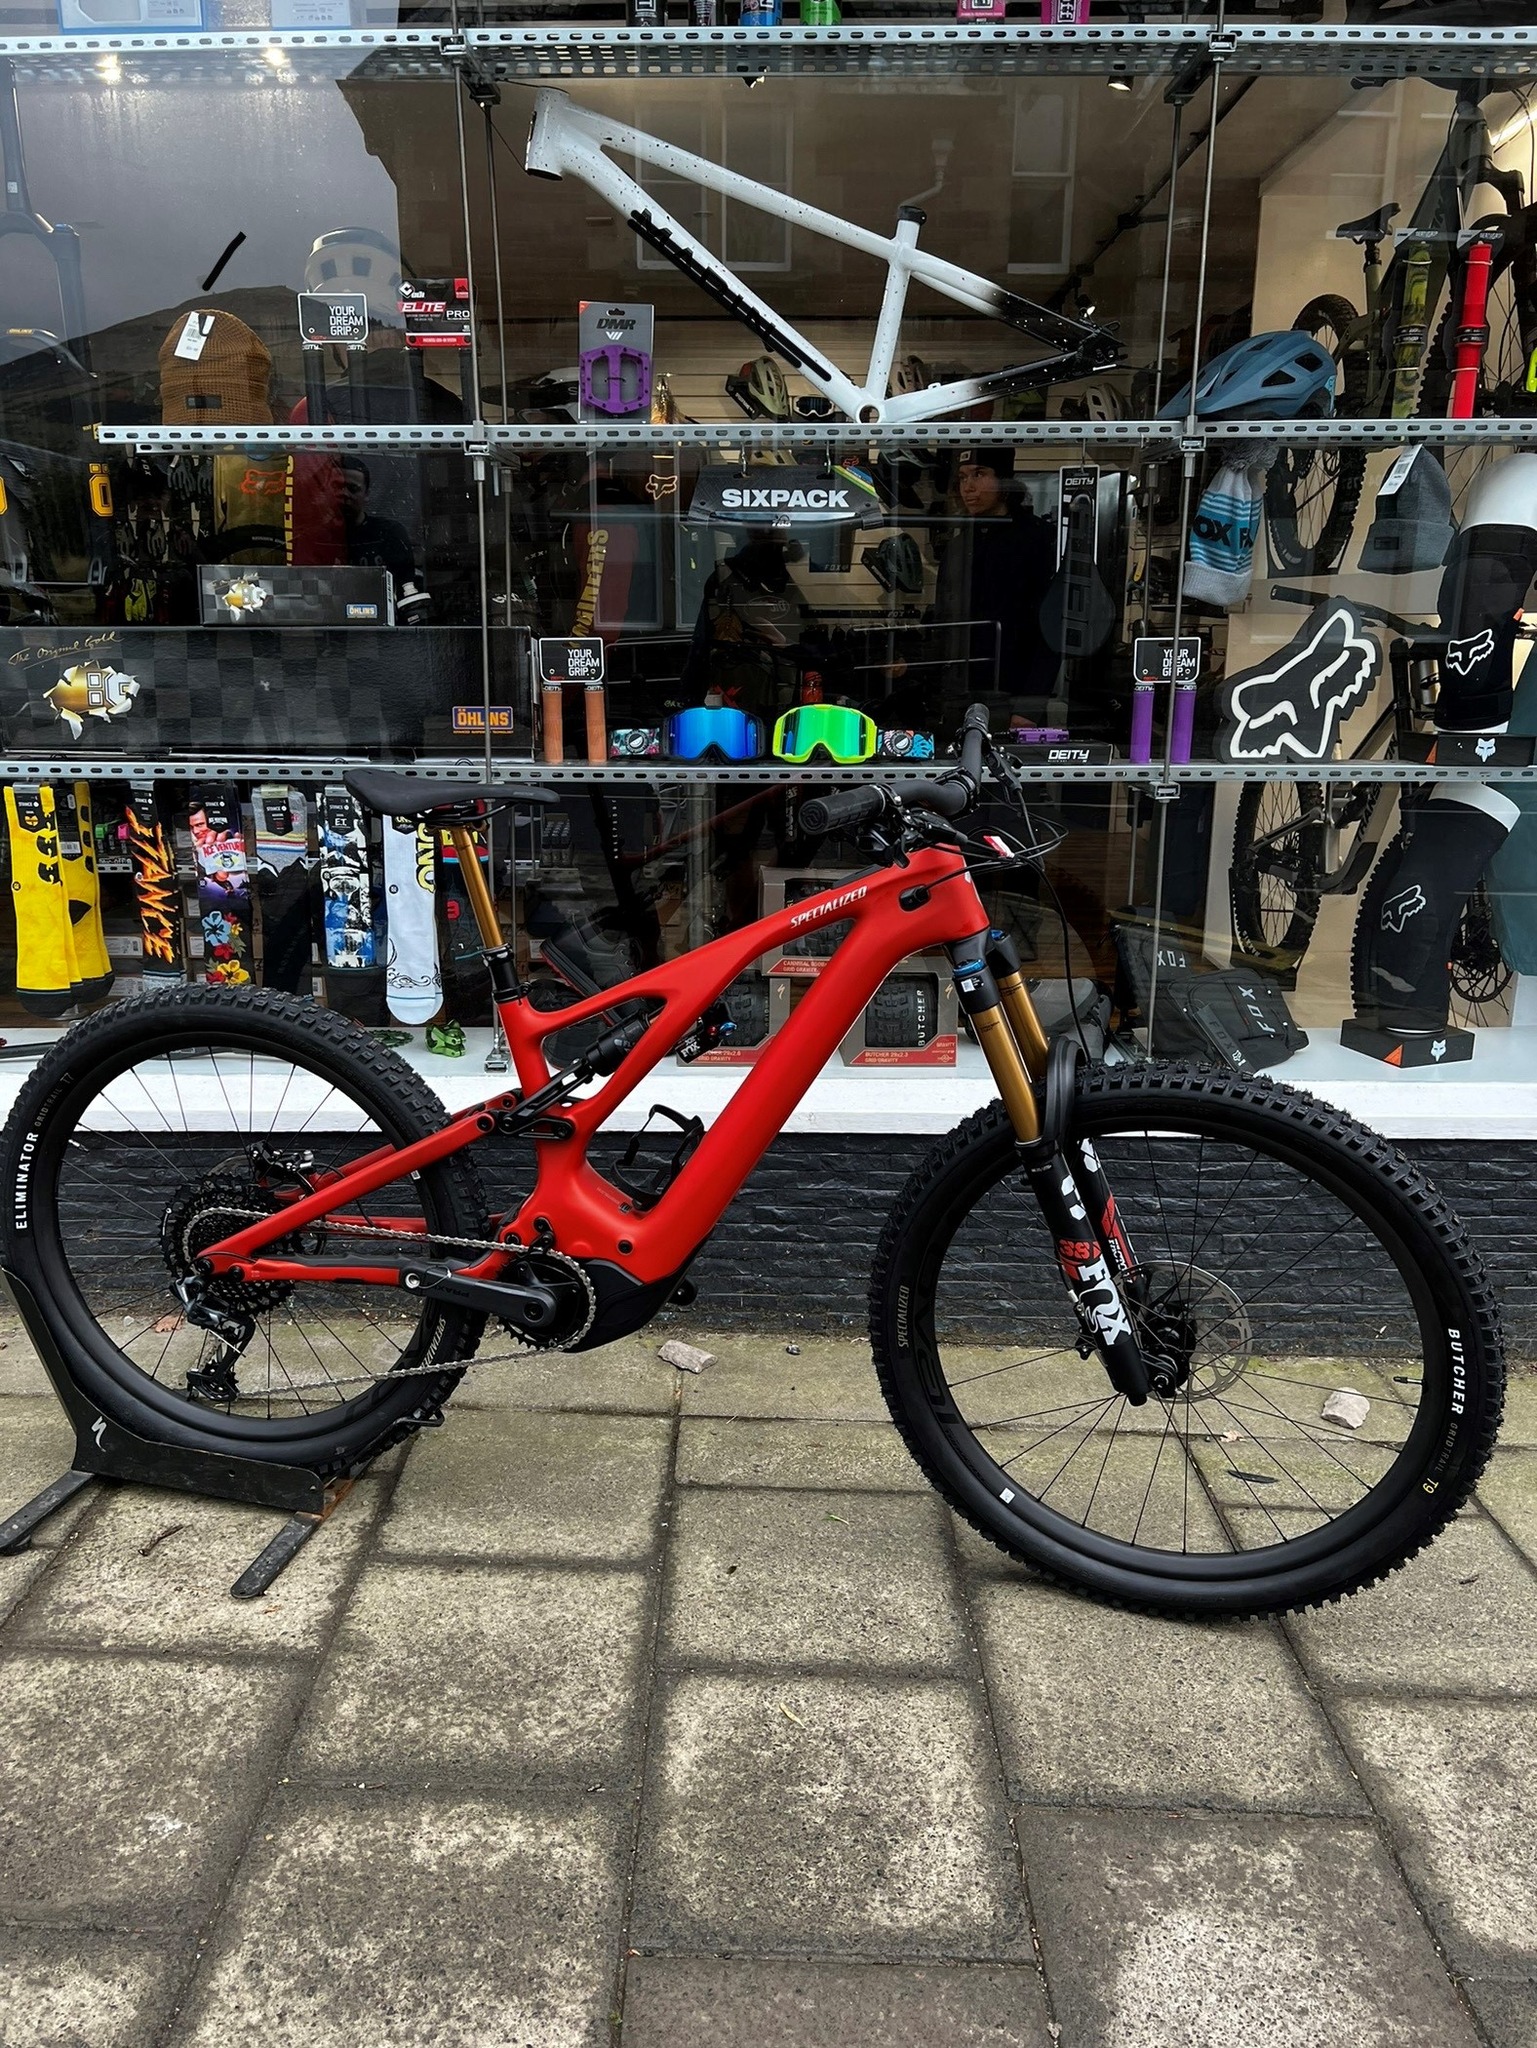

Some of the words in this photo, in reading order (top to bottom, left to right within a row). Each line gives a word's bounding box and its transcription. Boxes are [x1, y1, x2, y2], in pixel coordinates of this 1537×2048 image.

[329, 305, 355, 316] YOUR
[402, 301, 447, 312] ELITE
[446, 310, 471, 318] PRO
[329, 316, 364, 326] DREAM
[596, 318, 636, 330] DMR
[330, 325, 353, 336] GRIP.
[1064, 477, 1095, 486] DEITY
[721, 488, 850, 508] SIXPACK
[1192, 514, 1233, 547] OX
[570, 529, 609, 640] NGINEERS
[8, 647, 31, 666] The
[567, 648, 593, 658] YOUR
[568, 657, 600, 668] DREAM
[568, 667, 590, 677] GRIP.
[1162, 667, 1184, 677] GP.
[457, 708, 510, 726] ÖHLNS
[1048, 749, 1090, 760] DEITY
[1357, 781, 1383, 843] TRANS
[202, 843, 215, 858] ACE
[790, 885, 868, 929] SPECIALIZED
[1157, 950, 1186, 968] FOX
[917, 988, 926, 1047] BUTCHER
[1237, 985, 1276, 1033] FOX
[1208, 1021, 1235, 1050] FOX
[15, 1132, 39, 1230] ELIMINATOR
[60, 1072, 75, 1084] T7
[1077, 1253, 1133, 1346] FOX
[897, 1284, 911, 1349] SPECIALIZED
[421, 1315, 447, 1368] SPECIALIZE
[1447, 1327, 1466, 1415] BUTCHER
[1422, 1477, 1439, 1495] T9
